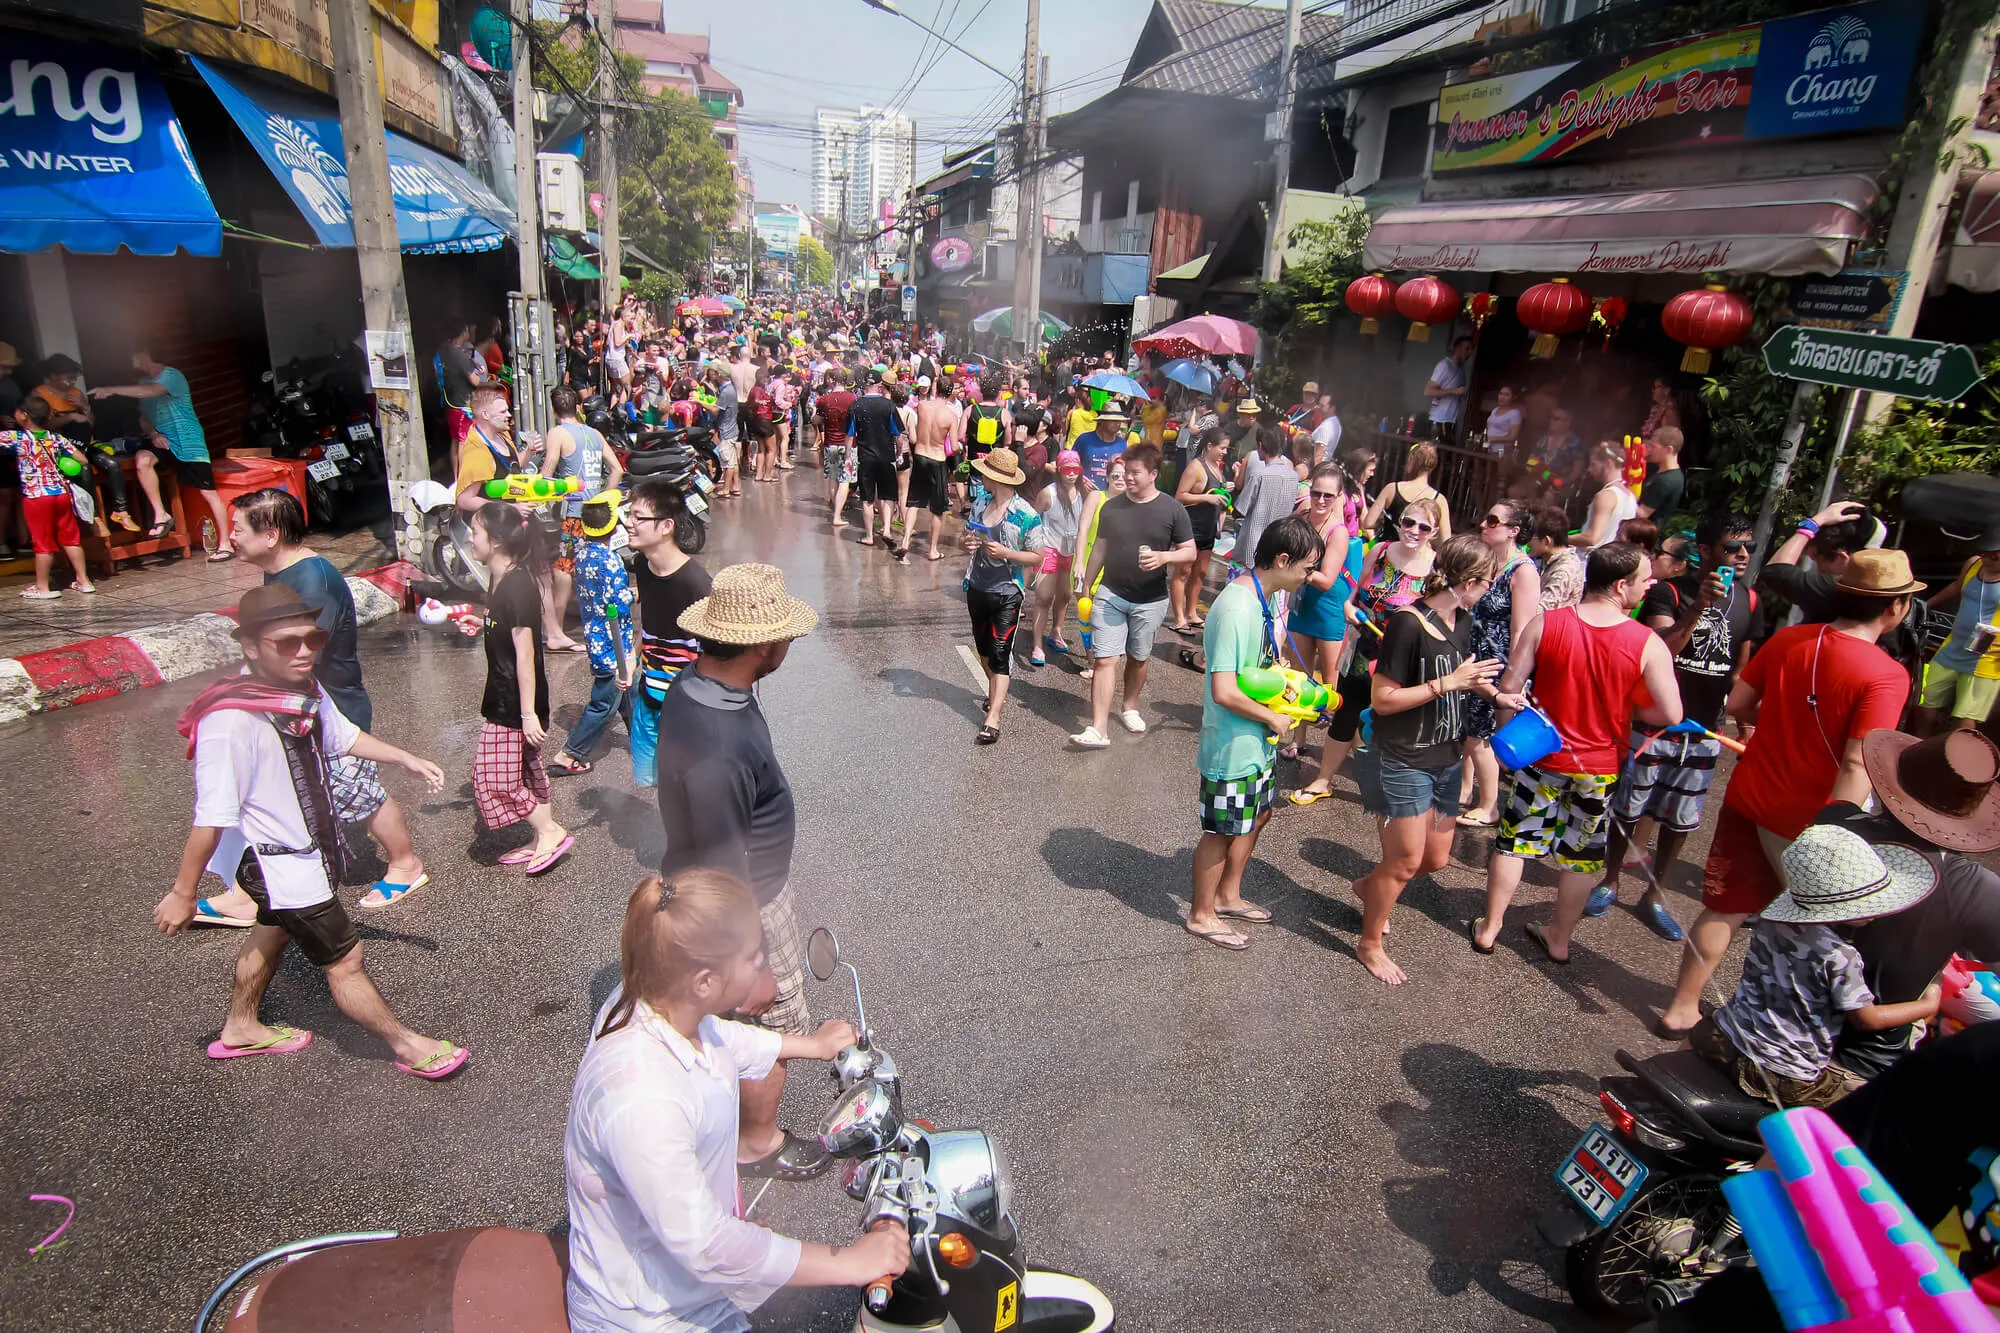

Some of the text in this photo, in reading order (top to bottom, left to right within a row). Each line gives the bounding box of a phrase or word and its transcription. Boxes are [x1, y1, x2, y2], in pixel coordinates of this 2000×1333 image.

[0, 59, 143, 144] ng
[1785, 73, 1878, 106] Chang
[1444, 68, 1738, 158] Jammer's Delight Bar
[11, 149, 135, 173] WATER
[1434, 245, 1480, 271] Delight
[1658, 239, 1733, 271] Delight
[1840, 303, 1868, 313] ROAD
[1789, 332, 1947, 386] วัดลอยเคราะห์
[1567, 1166, 1606, 1211] 731
